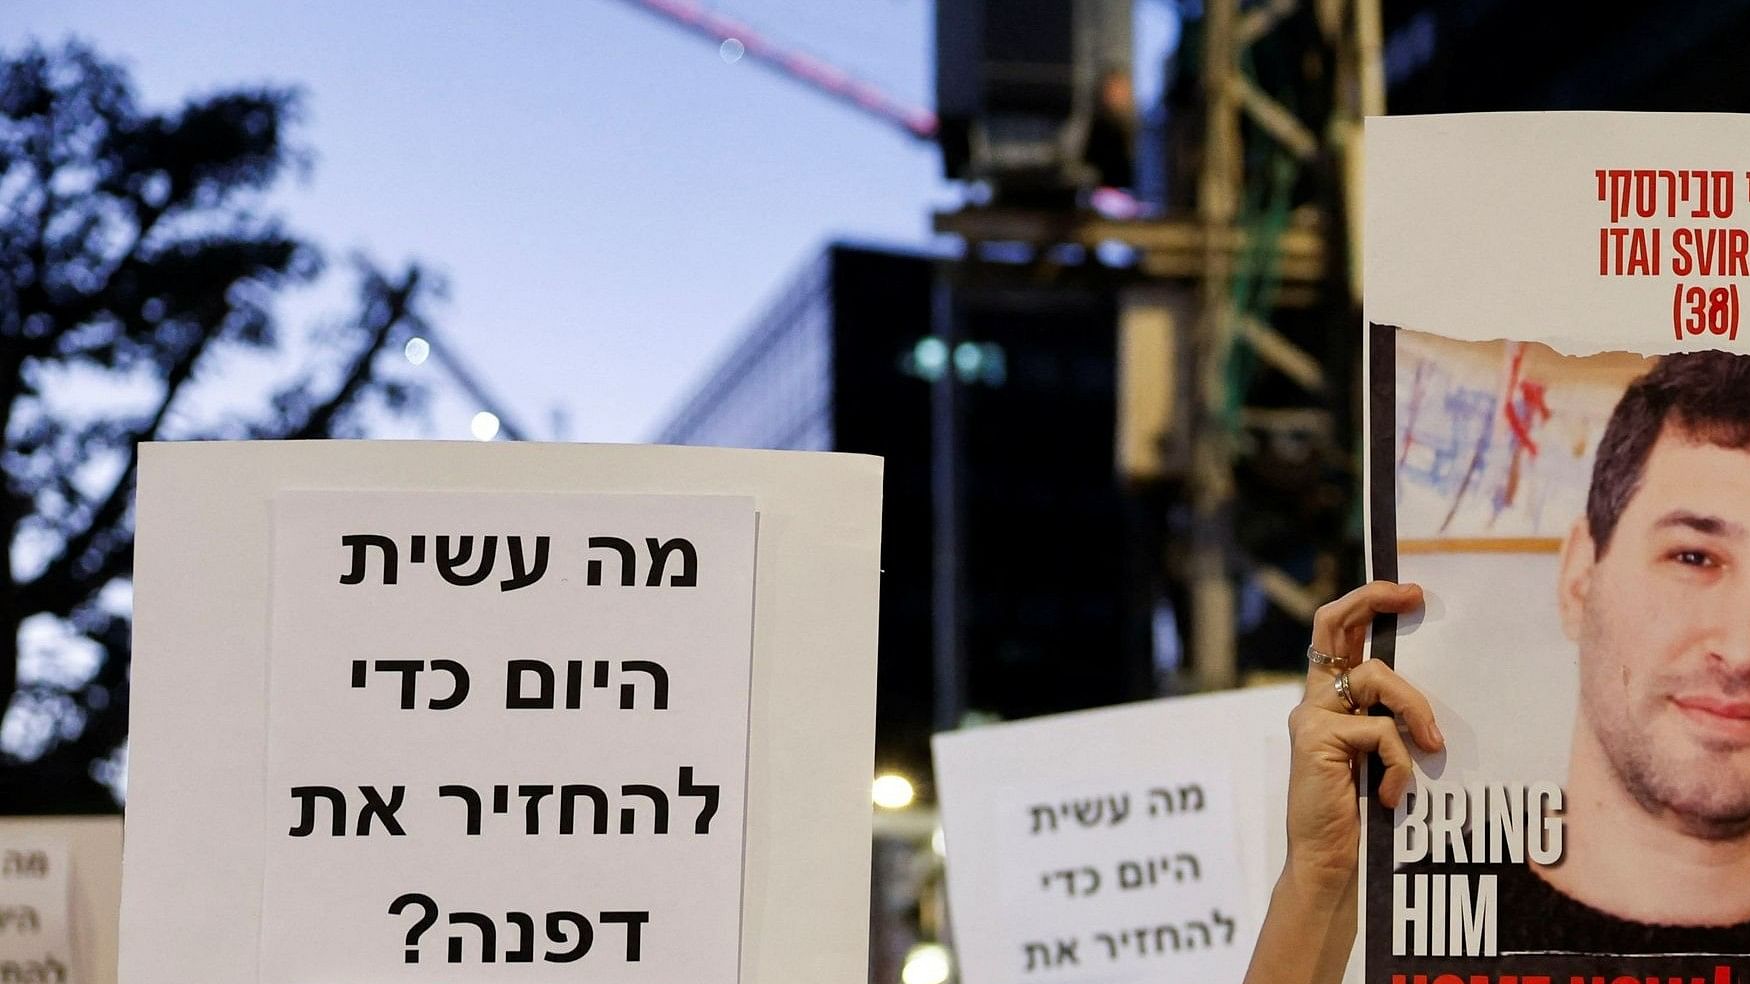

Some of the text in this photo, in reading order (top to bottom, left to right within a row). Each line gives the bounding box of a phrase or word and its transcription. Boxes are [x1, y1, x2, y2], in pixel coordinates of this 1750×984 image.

[1595, 169, 1734, 223] סבירסקי
[1599, 228, 1660, 276] ITAI
[1672, 284, 1740, 340] (38)
[339, 534, 699, 592] מה עשית
[351, 659, 669, 711] היום כדי
[288, 765, 721, 838] להחזיר את
[1029, 784, 1206, 834] מה עשית
[1394, 783, 1564, 865] BRING
[1041, 853, 1201, 897] היום כדי
[388, 893, 650, 965] דפנה?
[1024, 909, 1237, 972] להחזיר את
[1392, 873, 1498, 957] HIM
